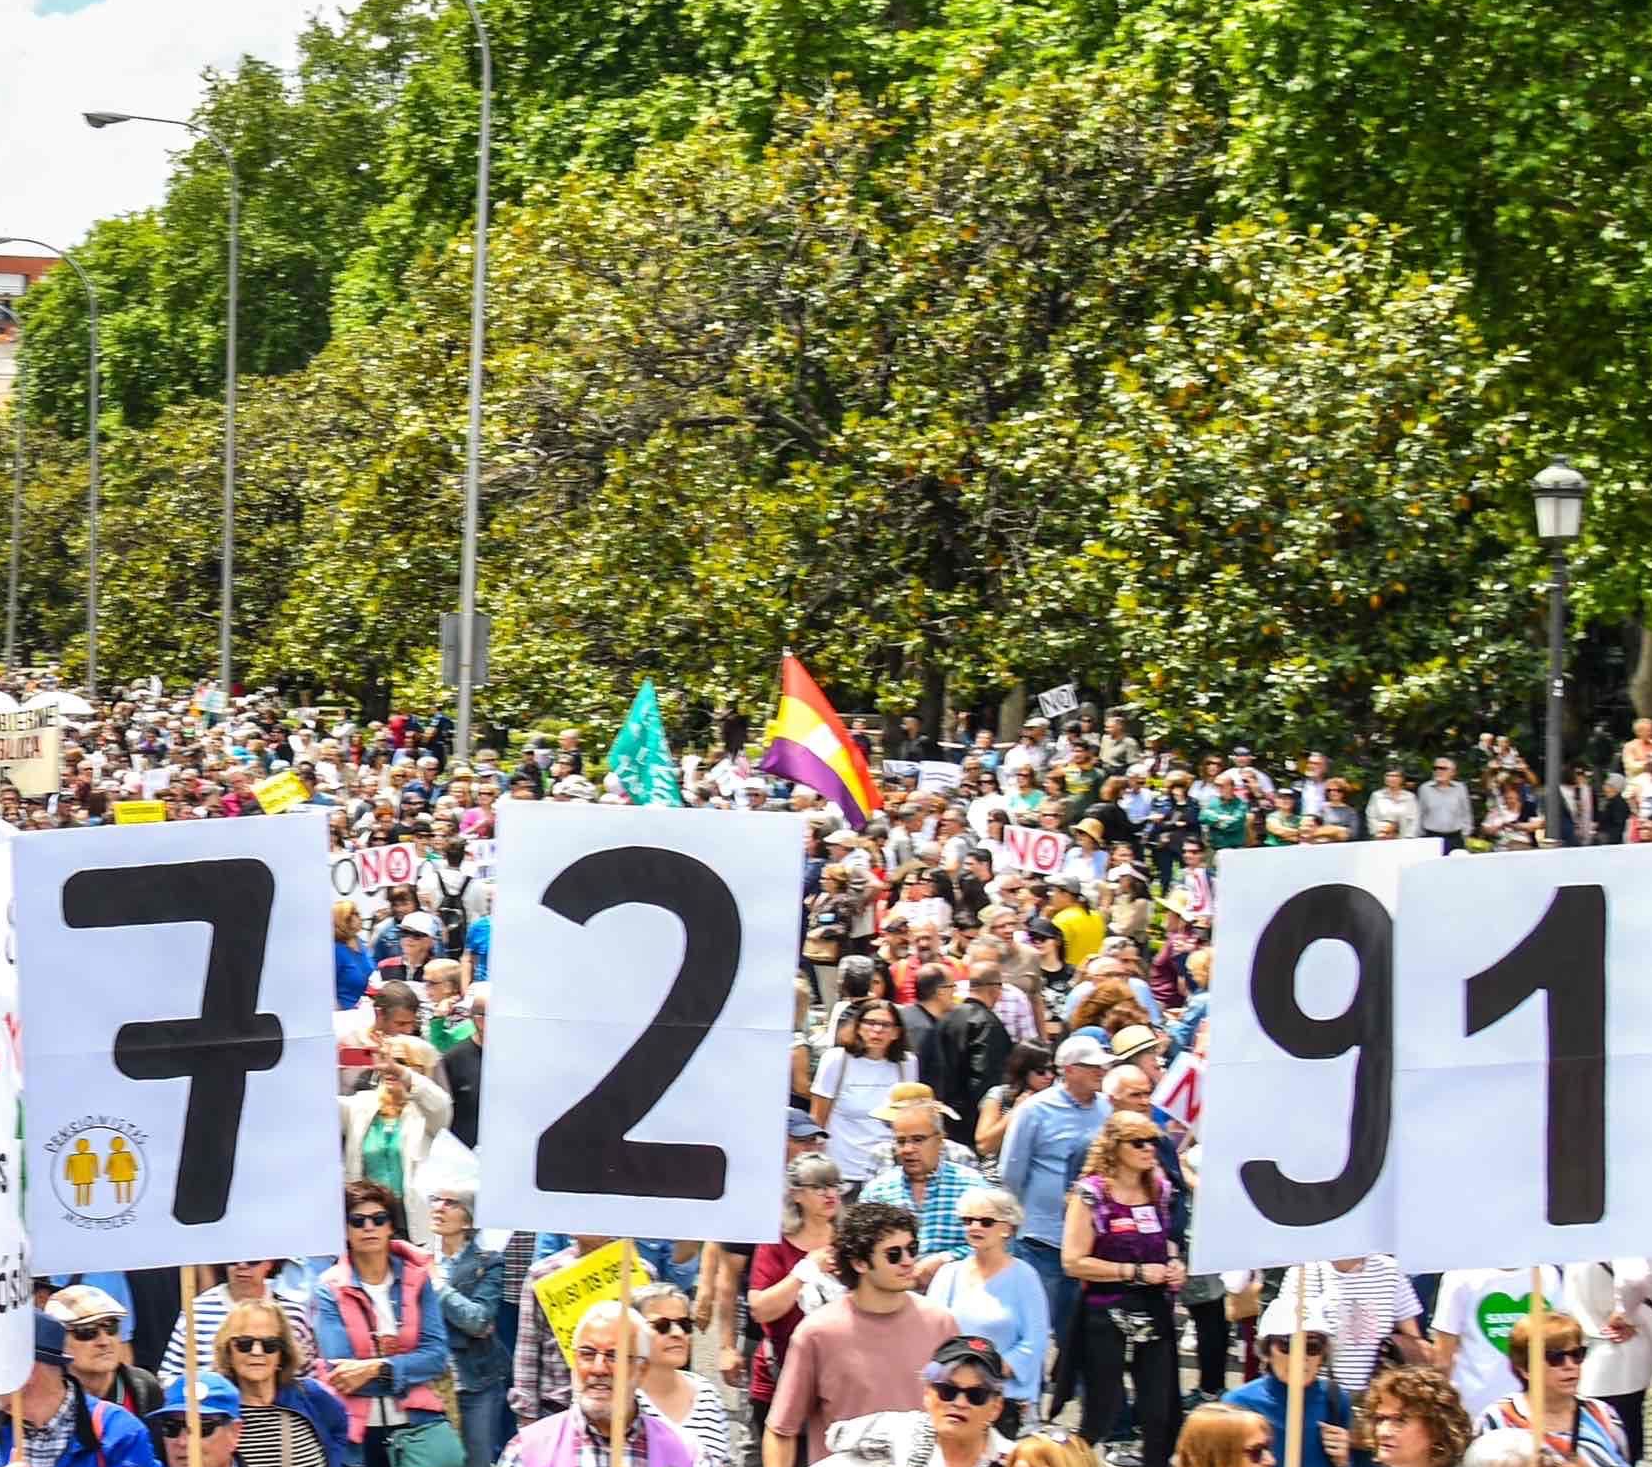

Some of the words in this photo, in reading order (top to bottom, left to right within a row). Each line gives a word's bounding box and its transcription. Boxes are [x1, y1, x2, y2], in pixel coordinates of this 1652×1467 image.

[62, 858, 283, 1227] 7
[360, 846, 412, 889] NO
[536, 845, 743, 1201] 2
